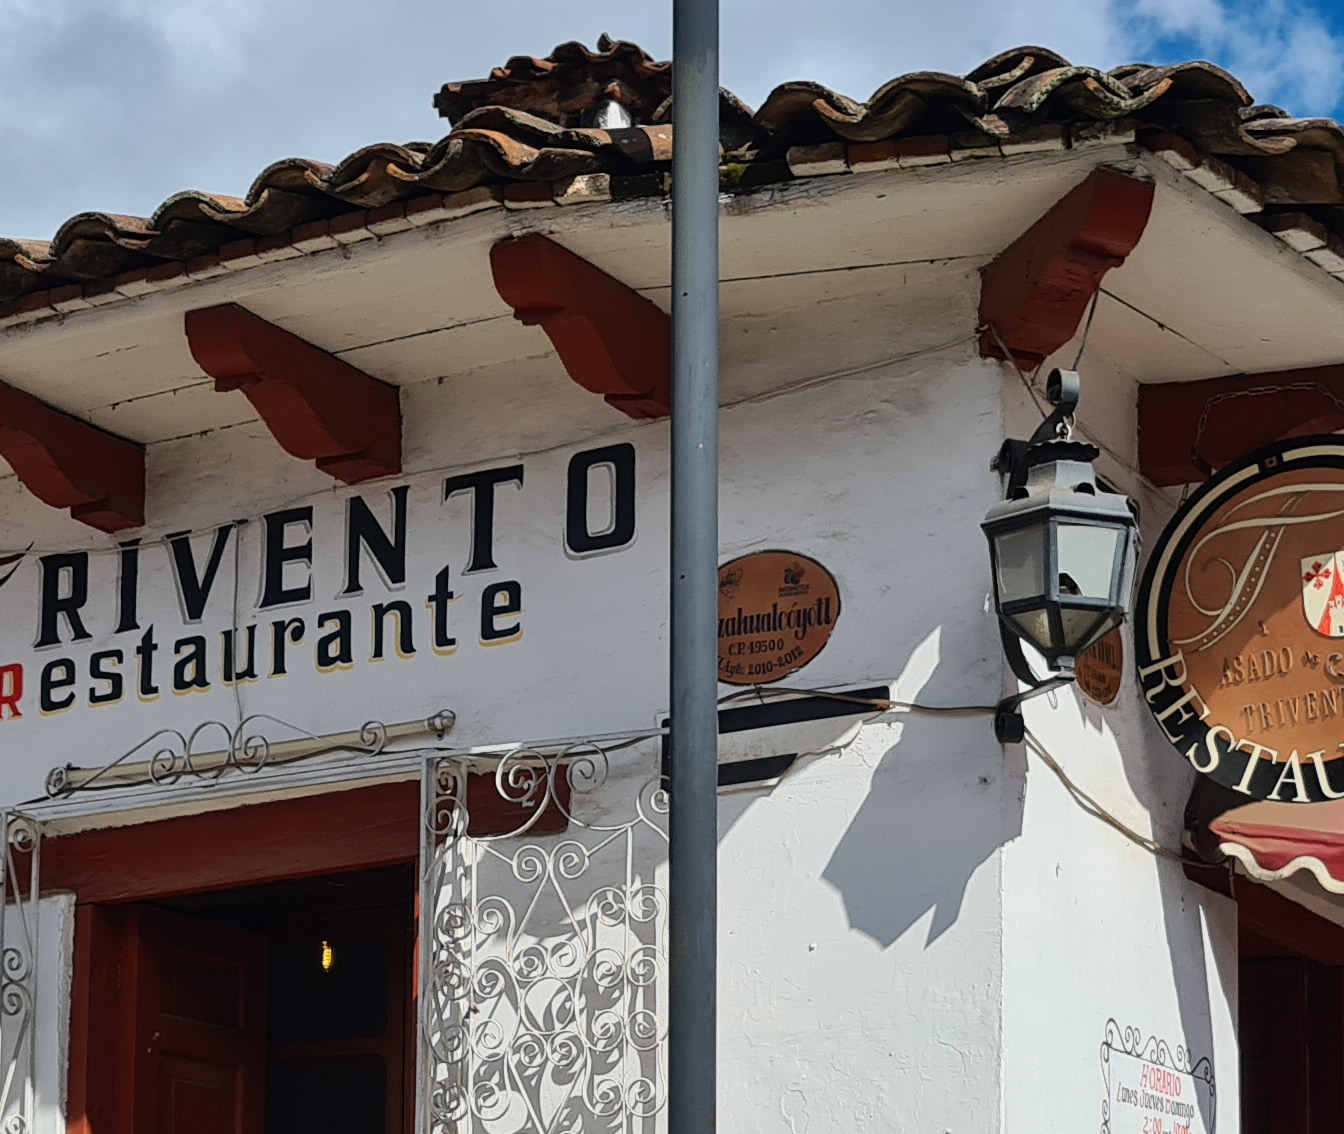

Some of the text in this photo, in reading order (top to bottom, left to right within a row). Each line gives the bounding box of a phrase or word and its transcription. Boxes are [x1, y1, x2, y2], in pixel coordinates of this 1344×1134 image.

[718, 597, 832, 641] zahualcóyotl
[1220, 646, 1294, 687] ASADO
[1139, 1063, 1183, 1097] HORARIO
